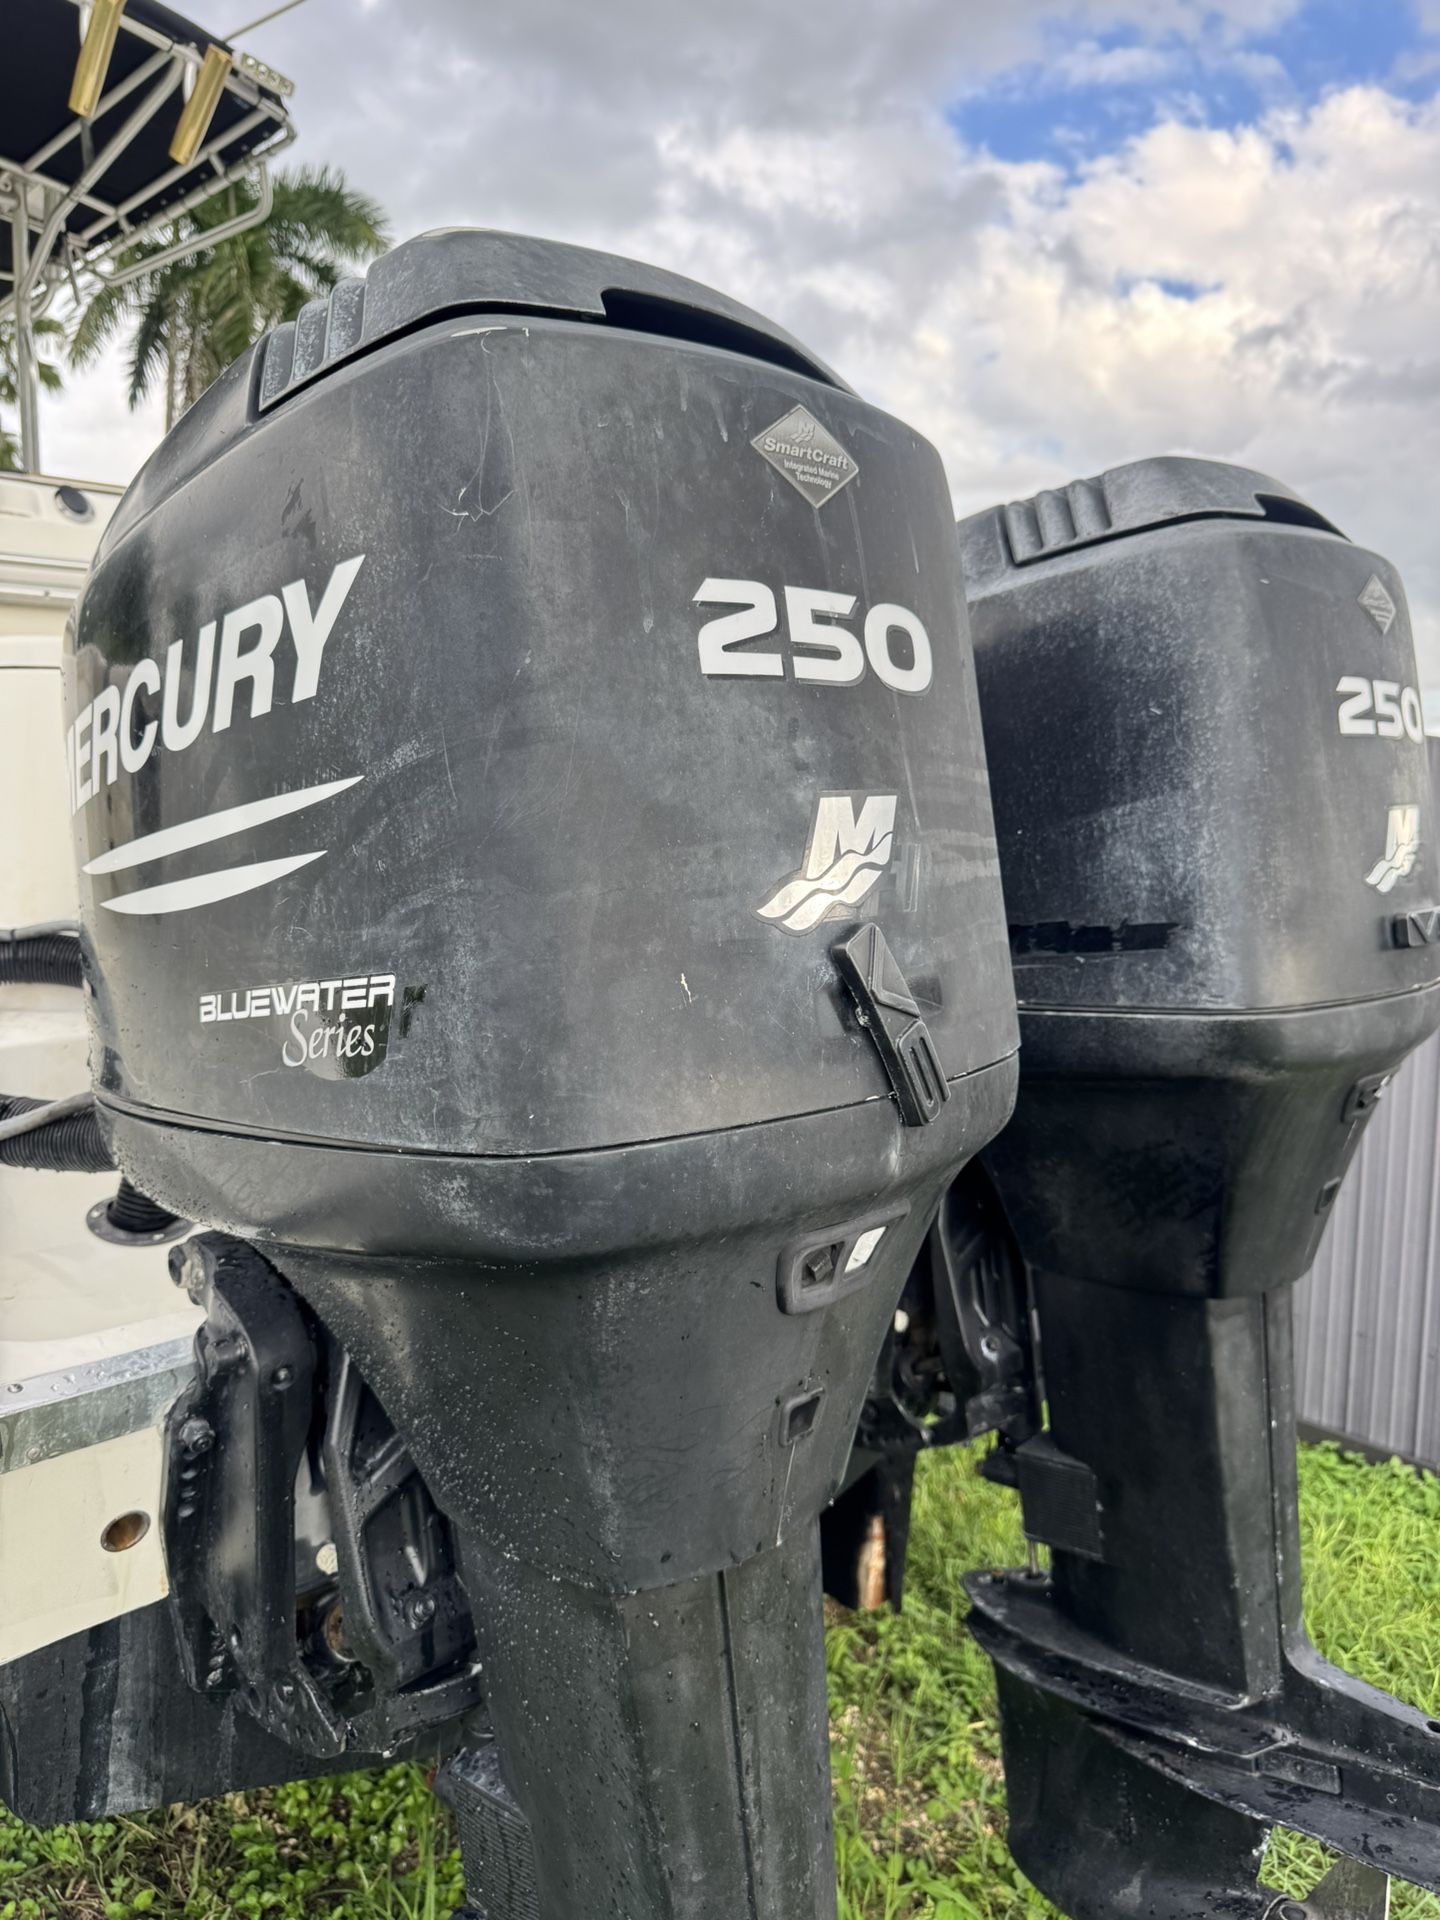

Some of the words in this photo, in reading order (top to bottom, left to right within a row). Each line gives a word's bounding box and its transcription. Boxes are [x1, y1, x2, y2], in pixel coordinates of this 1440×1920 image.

[764, 437, 848, 470] SmartCraft
[783, 458, 817, 475] Integrated
[795, 471, 832, 489] Technology
[692, 577, 933, 692] 250
[67, 554, 366, 816] ERCURY
[1336, 675, 1424, 744] 250
[200, 974, 396, 1022] BLUEWATER
[282, 1008, 375, 1067] Series
